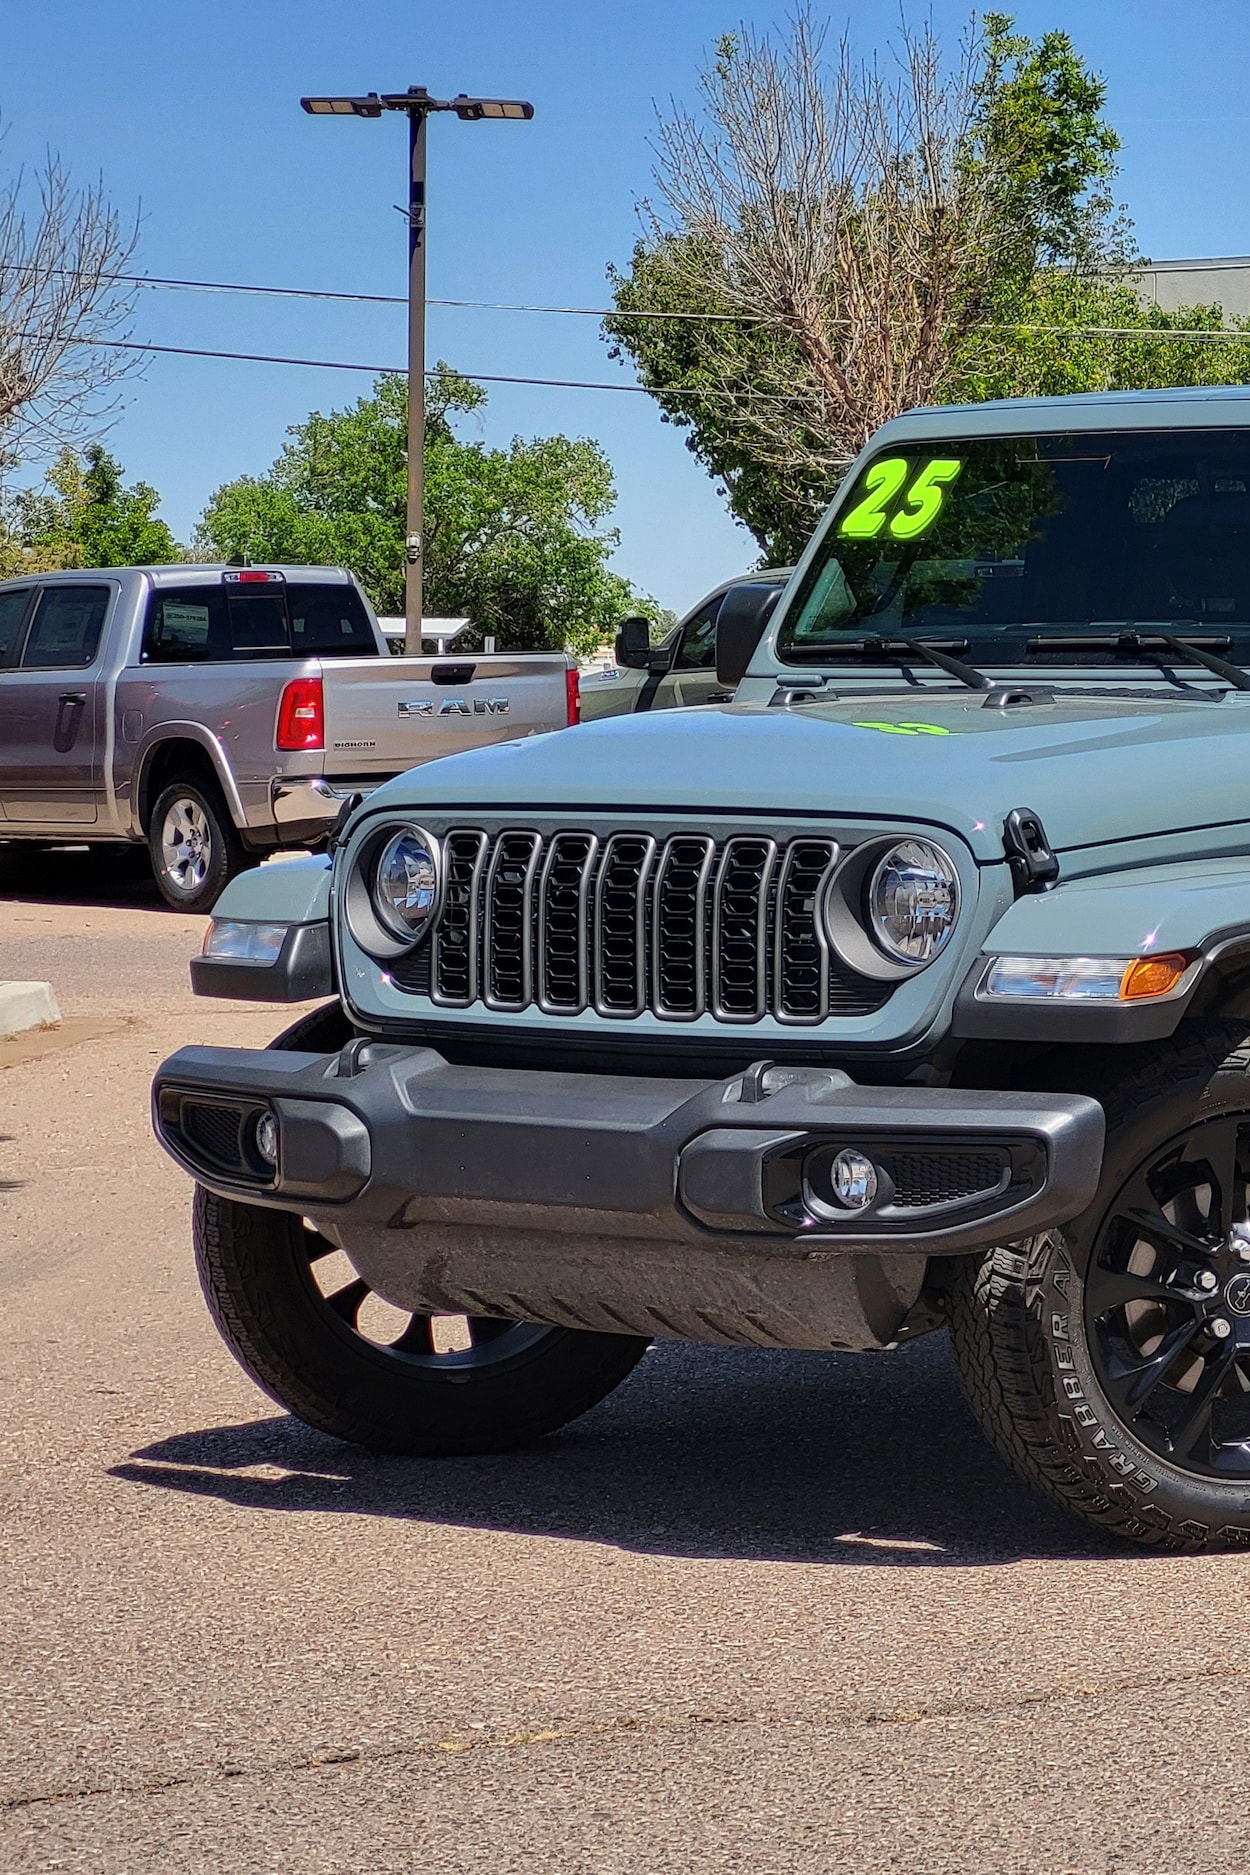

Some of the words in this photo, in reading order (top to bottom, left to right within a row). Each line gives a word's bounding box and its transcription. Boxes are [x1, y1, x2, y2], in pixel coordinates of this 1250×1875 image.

[841, 458, 960, 538] 25
[397, 697, 511, 718] RAM
[1051, 1311, 1160, 1495] GRABBER
